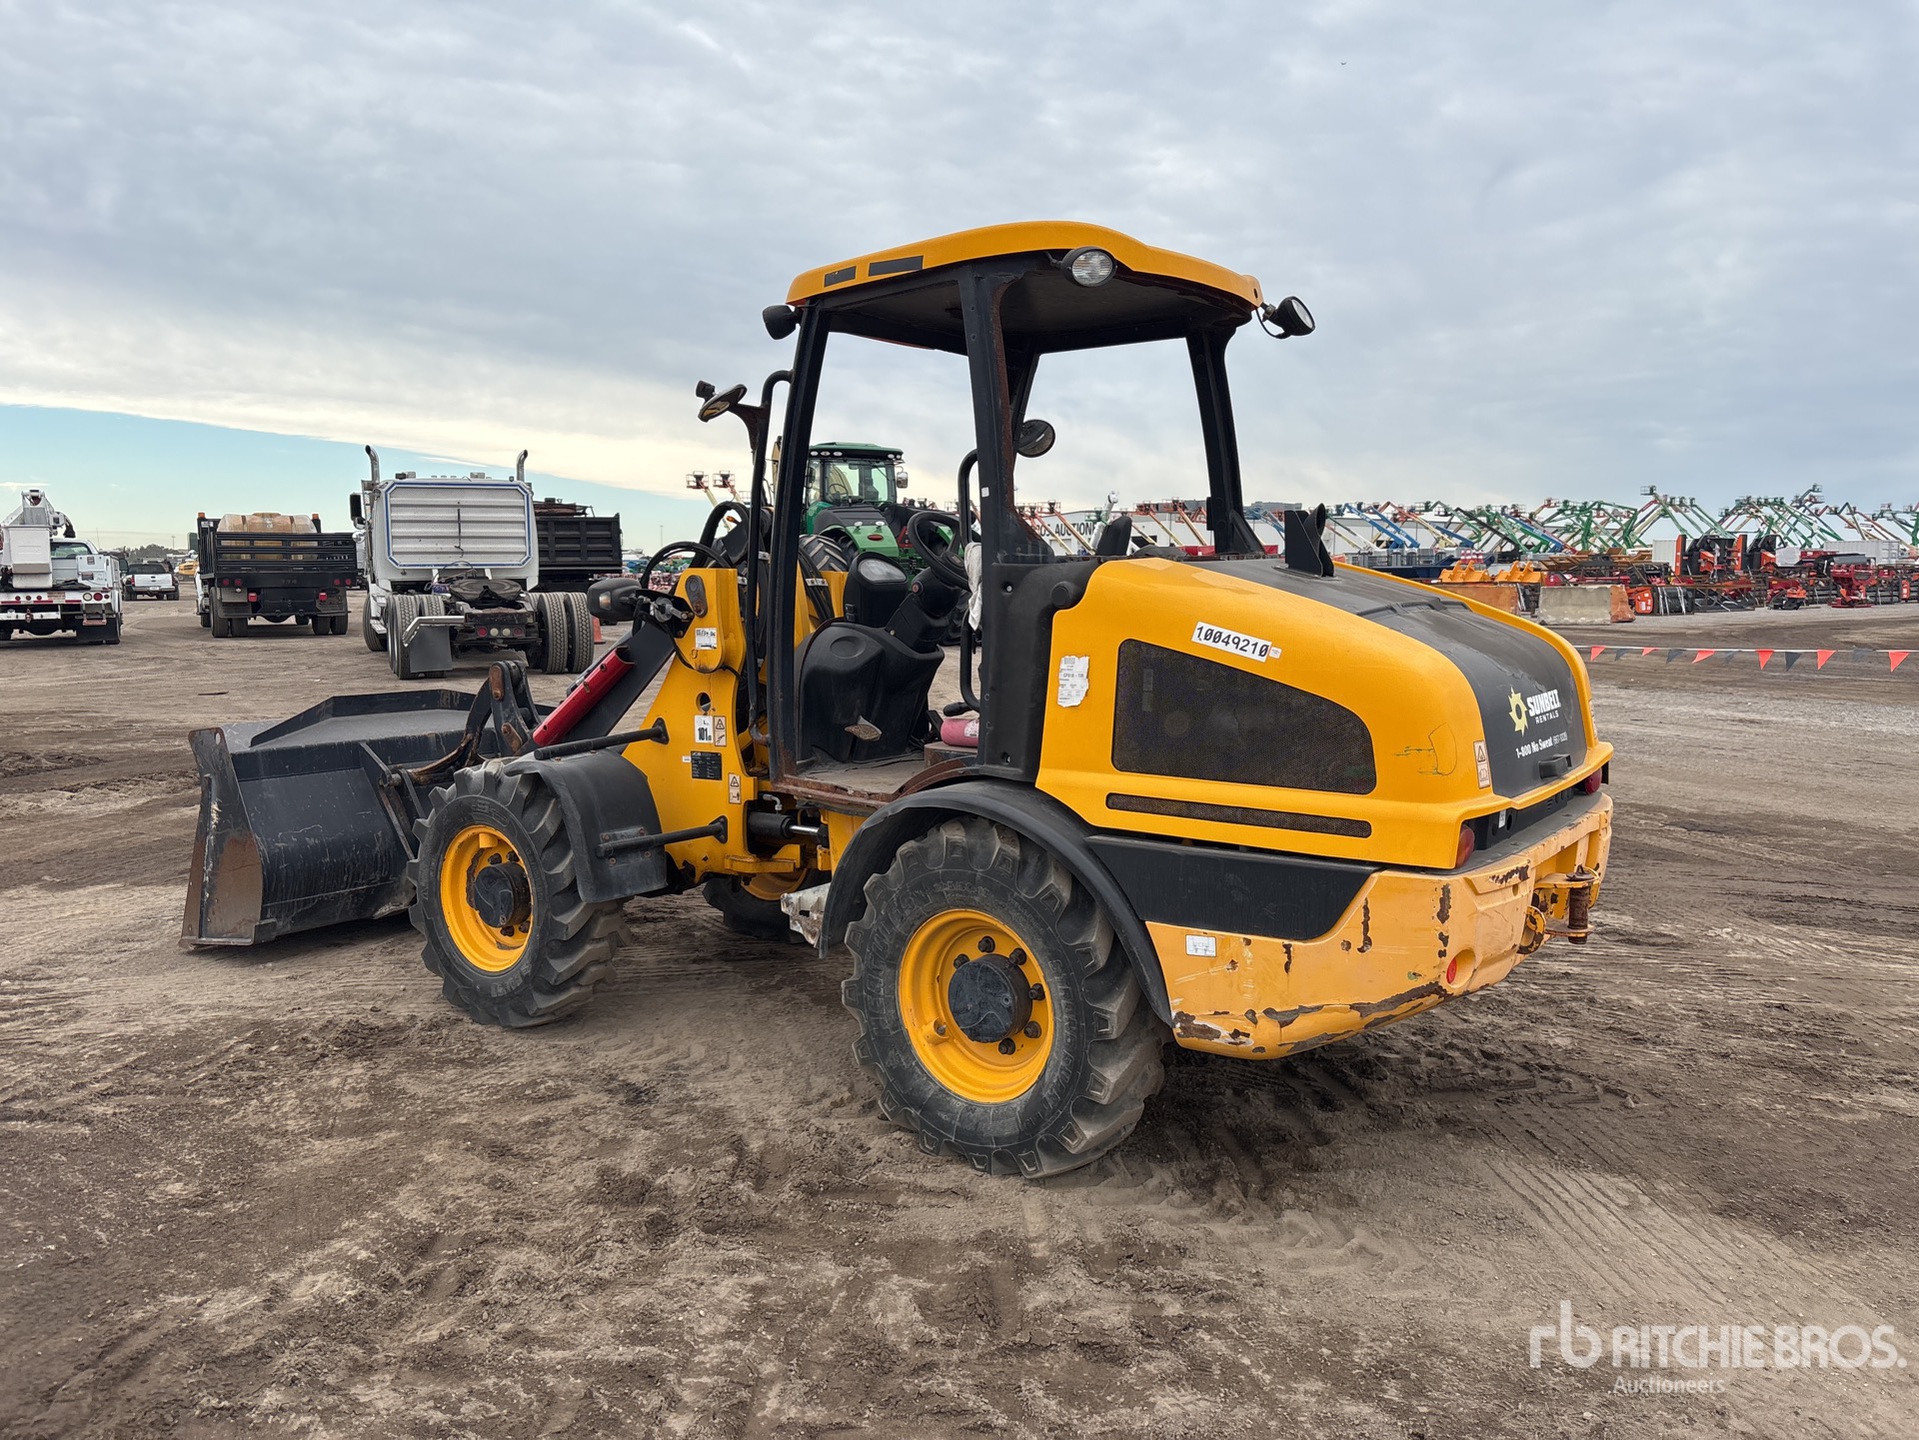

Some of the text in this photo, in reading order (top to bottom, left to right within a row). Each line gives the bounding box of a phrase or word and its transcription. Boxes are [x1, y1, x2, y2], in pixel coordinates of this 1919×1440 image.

[1197, 626, 1269, 658] 10049210
[1526, 689, 1561, 717] SUNBELT
[1535, 710, 1559, 724] RENTALS
[1516, 744, 1532, 759] 1-800
[1531, 741, 1539, 754] No
[1538, 736, 1553, 751] Sweat
